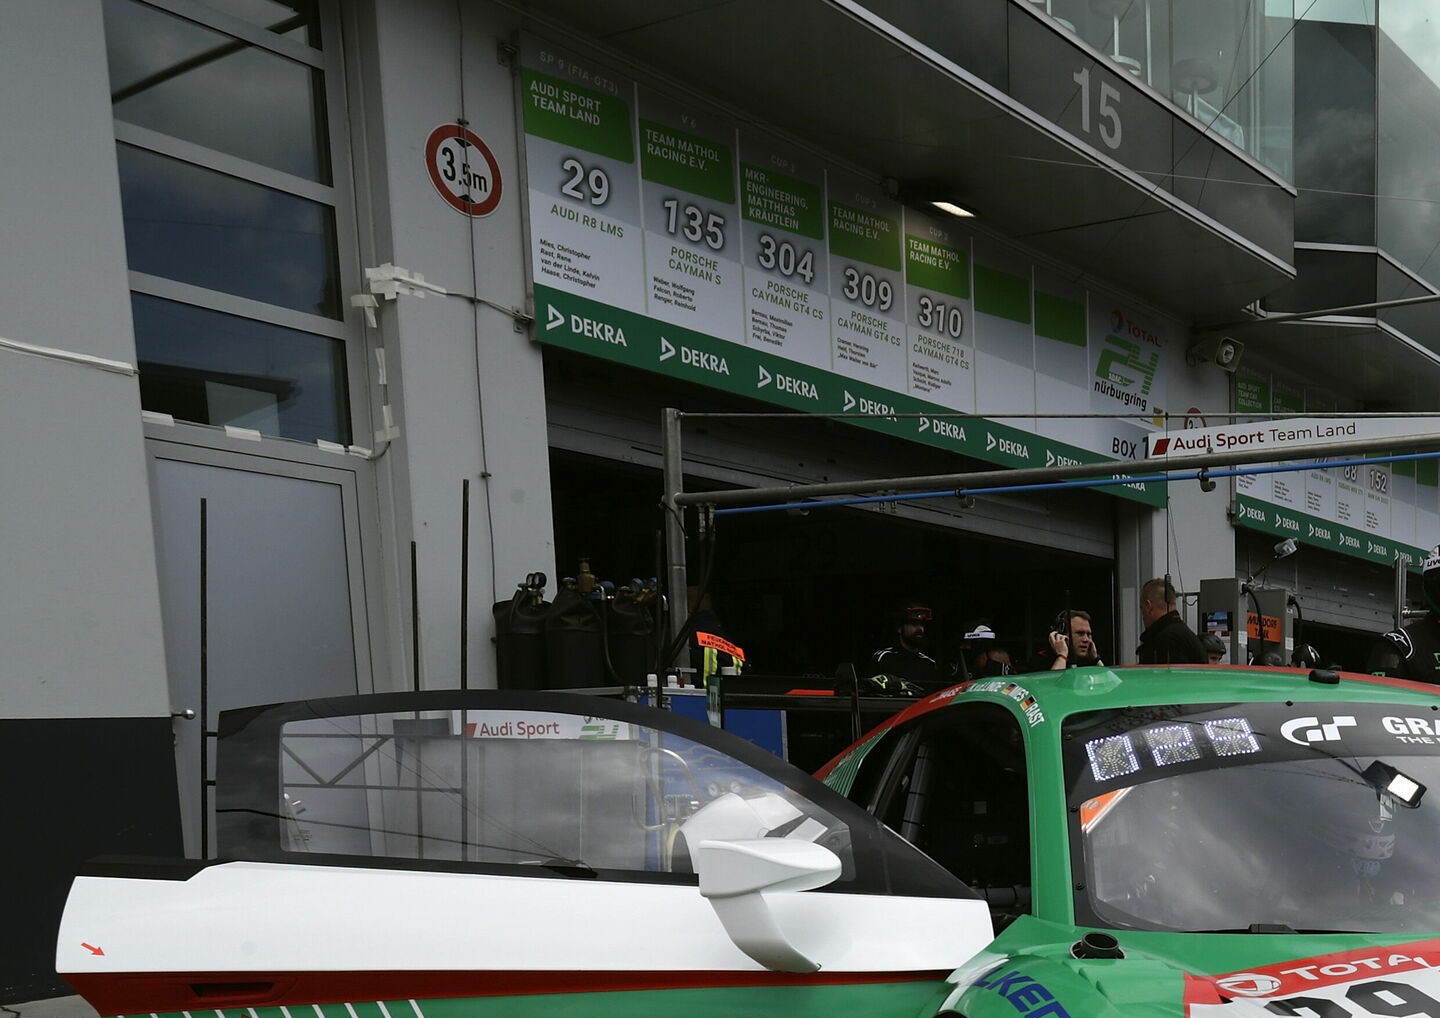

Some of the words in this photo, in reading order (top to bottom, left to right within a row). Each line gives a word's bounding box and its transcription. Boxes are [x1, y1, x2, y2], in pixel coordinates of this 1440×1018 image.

[530, 80, 559, 99] AUDI
[562, 89, 601, 111] SPORT
[1073, 67, 1122, 149] 15
[532, 94, 566, 116] TEAM
[569, 107, 601, 126] LAND
[646, 129, 675, 150] TEAM
[678, 141, 721, 162] MATHOL
[647, 143, 686, 166] RACING
[689, 156, 708, 171] E.V.
[561, 159, 609, 206] 29
[745, 168, 769, 182] MKR-
[746, 181, 809, 210] ENGINEERING,
[747, 194, 796, 217] MATTHIAS
[550, 204, 579, 223] AUDI
[582, 212, 597, 229] R8
[600, 221, 624, 238] LMS
[664, 200, 725, 250] 135
[833, 206, 855, 221] TEAM
[857, 214, 890, 232] MATHOL
[833, 218, 864, 236] RACING
[866, 229, 880, 241] E.V.
[539, 238, 556, 250] Mies,
[557, 244, 591, 260] Christopher
[540, 248, 555, 260] Rast,
[556, 254, 572, 263] Rene
[671, 246, 718, 272] PORSCHE
[758, 235, 814, 283] 304
[909, 239, 929, 254] TEAM
[931, 245, 960, 263] MATHOL
[909, 250, 937, 267] RACING
[938, 260, 952, 271] E.V.
[541, 258, 552, 267] van
[552, 260, 563, 269] der
[564, 264, 581, 276] Linde,
[582, 270, 600, 281] Kelvin
[541, 266, 561, 280] Haase,
[562, 273, 596, 289] Christopher
[669, 258, 713, 282] CAYMAN
[715, 275, 722, 285] S
[767, 280, 808, 303] PORSCHE
[843, 268, 892, 310] 309
[752, 288, 790, 309] CAYMAN
[793, 301, 810, 315] GT4
[812, 308, 824, 320] CS
[851, 310, 888, 330] PORSCHE
[918, 297, 962, 338] 310
[571, 314, 627, 347] DEKRA
[838, 317, 872, 337] CAYMAN
[874, 330, 889, 342] GT4
[890, 336, 901, 346] CS
[1125, 319, 1162, 347] TOTAL
[913, 344, 943, 362] CAYMAN
[945, 355, 959, 366] GT4
[960, 361, 969, 370] CS
[918, 334, 951, 354] PORSCHE
[952, 346, 965, 358] 718
[681, 345, 730, 376] DEKRA
[776, 373, 819, 401] DEKRA
[1094, 381, 1147, 411] nürburgring
[860, 398, 897, 422] DEKRA
[933, 418, 967, 442] DEKRA
[1173, 434, 1211, 451] Audi
[1216, 431, 1264, 449] Sport
[1269, 429, 1312, 442] Team
[1316, 422, 1356, 438] Land
[999, 438, 1029, 460] DEKRA
[1112, 437, 1137, 459] BOX
[1369, 469, 1387, 492] 152
[1246, 506, 1266, 523] DEKRA
[1282, 517, 1300, 532] DEKRA
[1315, 527, 1331, 541] DEKRA
[1345, 536, 1360, 549] DEKRA
[1373, 544, 1388, 557] DEKRA
[1025, 703, 1045, 728] RAST
[480, 722, 512, 737] Audi
[516, 721, 560, 740] Sport
[1395, 736, 1435, 745] THE
